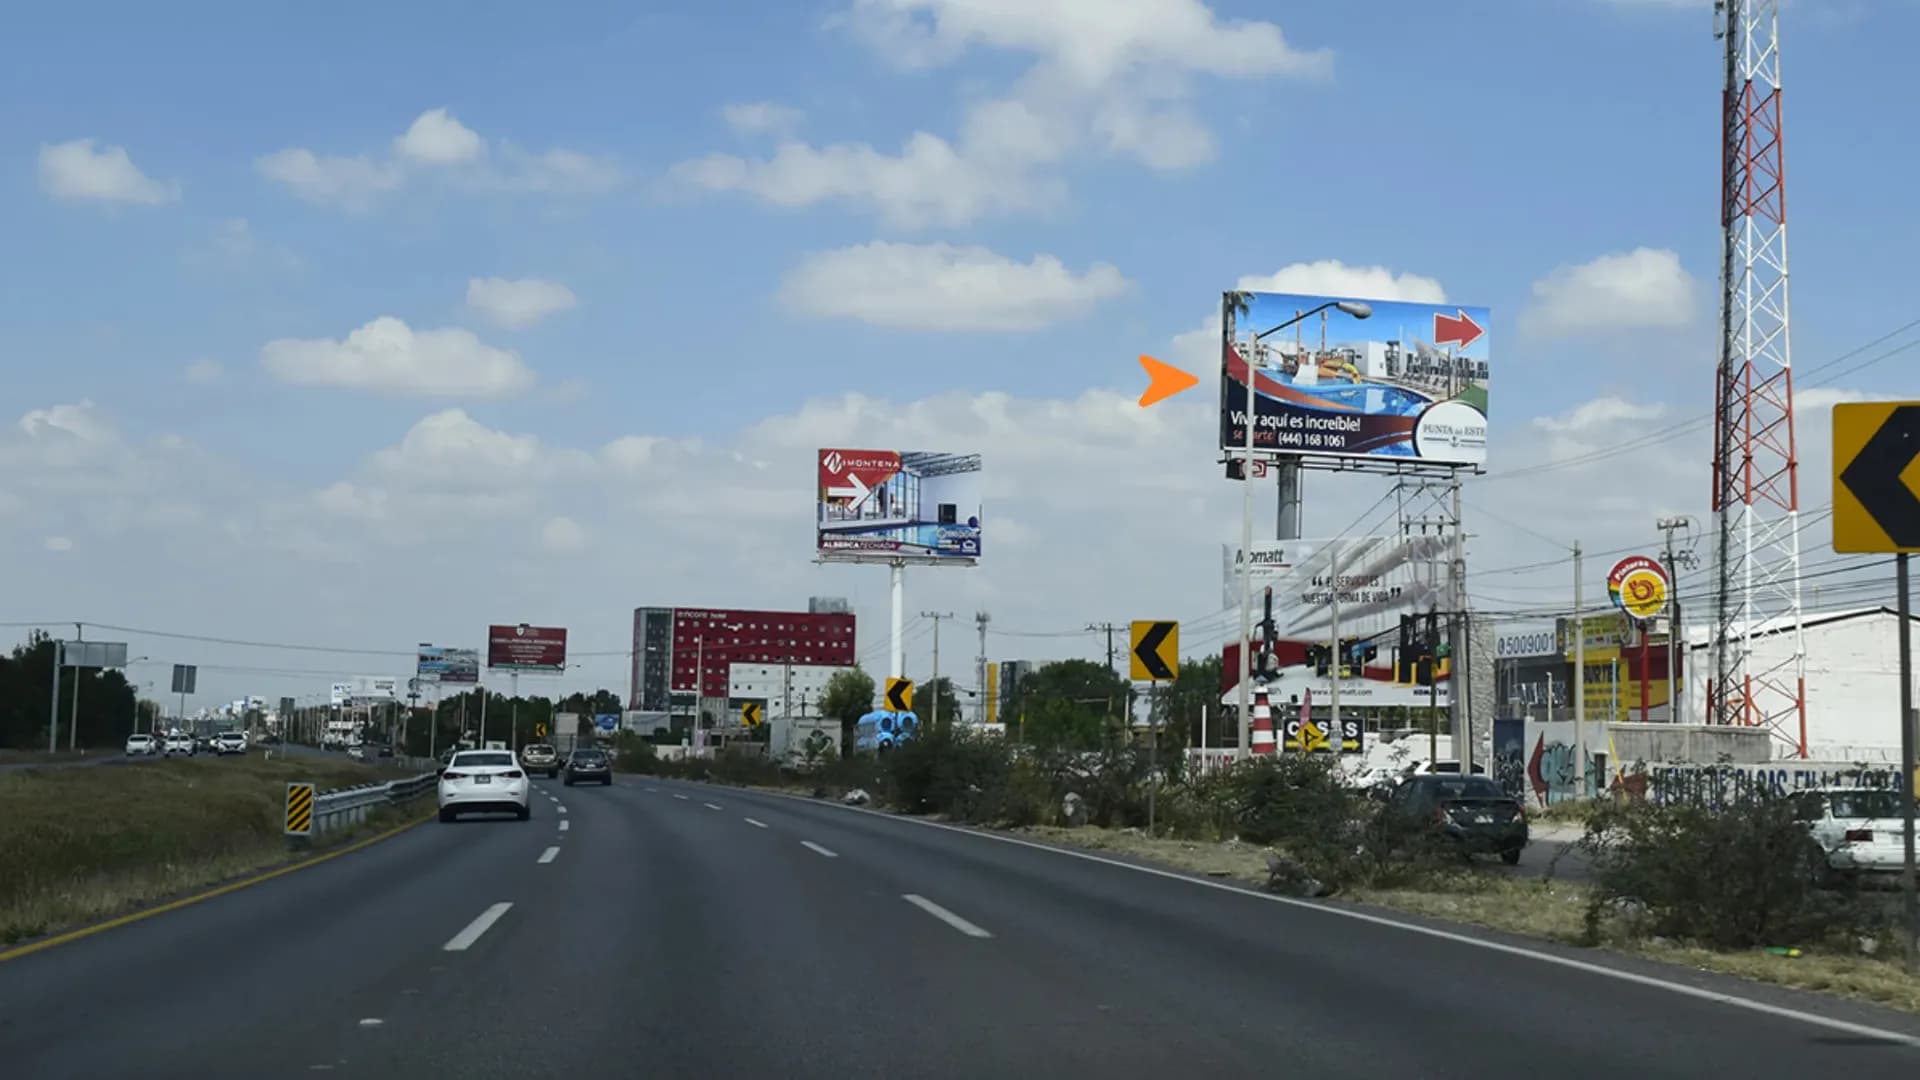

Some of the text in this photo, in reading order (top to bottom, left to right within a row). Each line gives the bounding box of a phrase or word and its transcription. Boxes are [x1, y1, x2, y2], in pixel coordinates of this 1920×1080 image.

[1231, 410, 1360, 431] Vivr aquí es increíble!
[1423, 424, 1453, 434] PUNTA
[1278, 432, 1302, 446] (444)
[1305, 433, 1321, 446] 168
[1324, 435, 1345, 447] 1061
[1614, 561, 1649, 580] Pinturas
